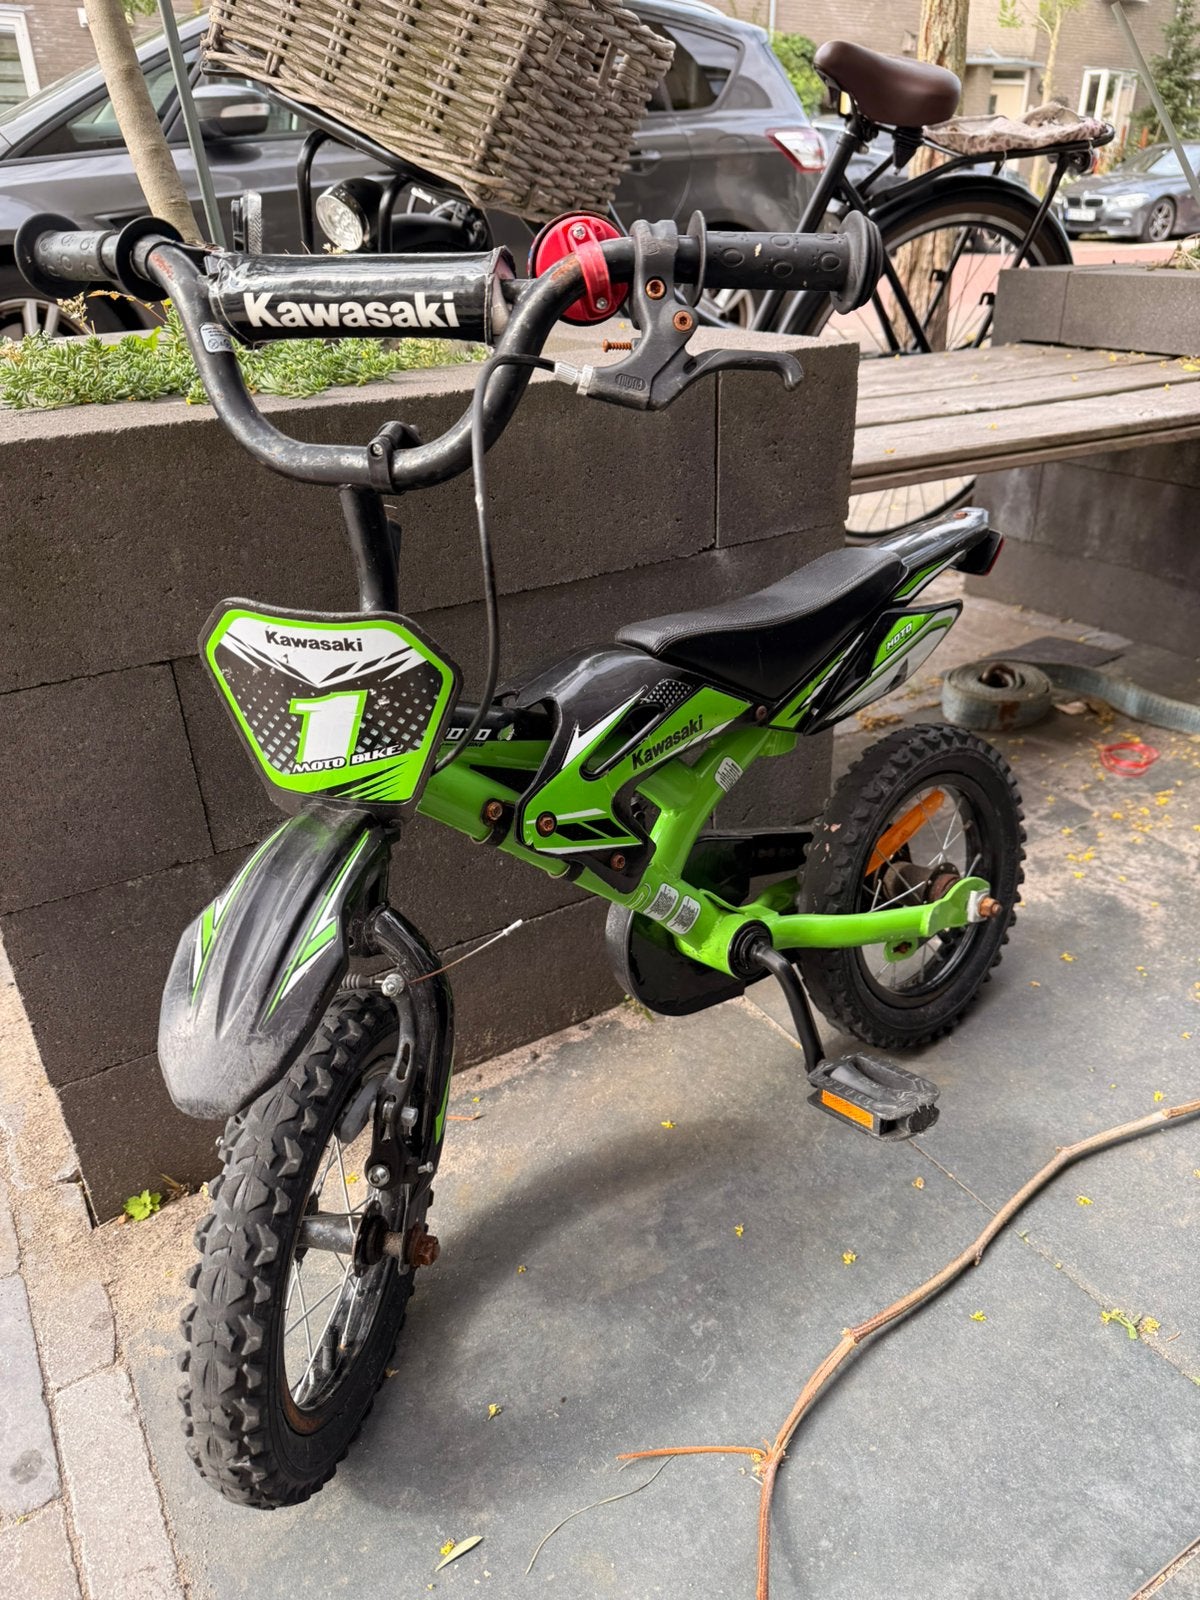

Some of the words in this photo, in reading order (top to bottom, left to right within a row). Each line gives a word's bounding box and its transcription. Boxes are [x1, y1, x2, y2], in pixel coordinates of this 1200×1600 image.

[243, 291, 460, 328] Kawasaki
[265, 630, 363, 652] Kawasaki
[886, 622, 913, 651] MOTO
[289, 689, 368, 764] 1
[631, 714, 703, 770] Kawasaki
[291, 757, 346, 774] MOTO
[351, 744, 402, 765] BIKE
